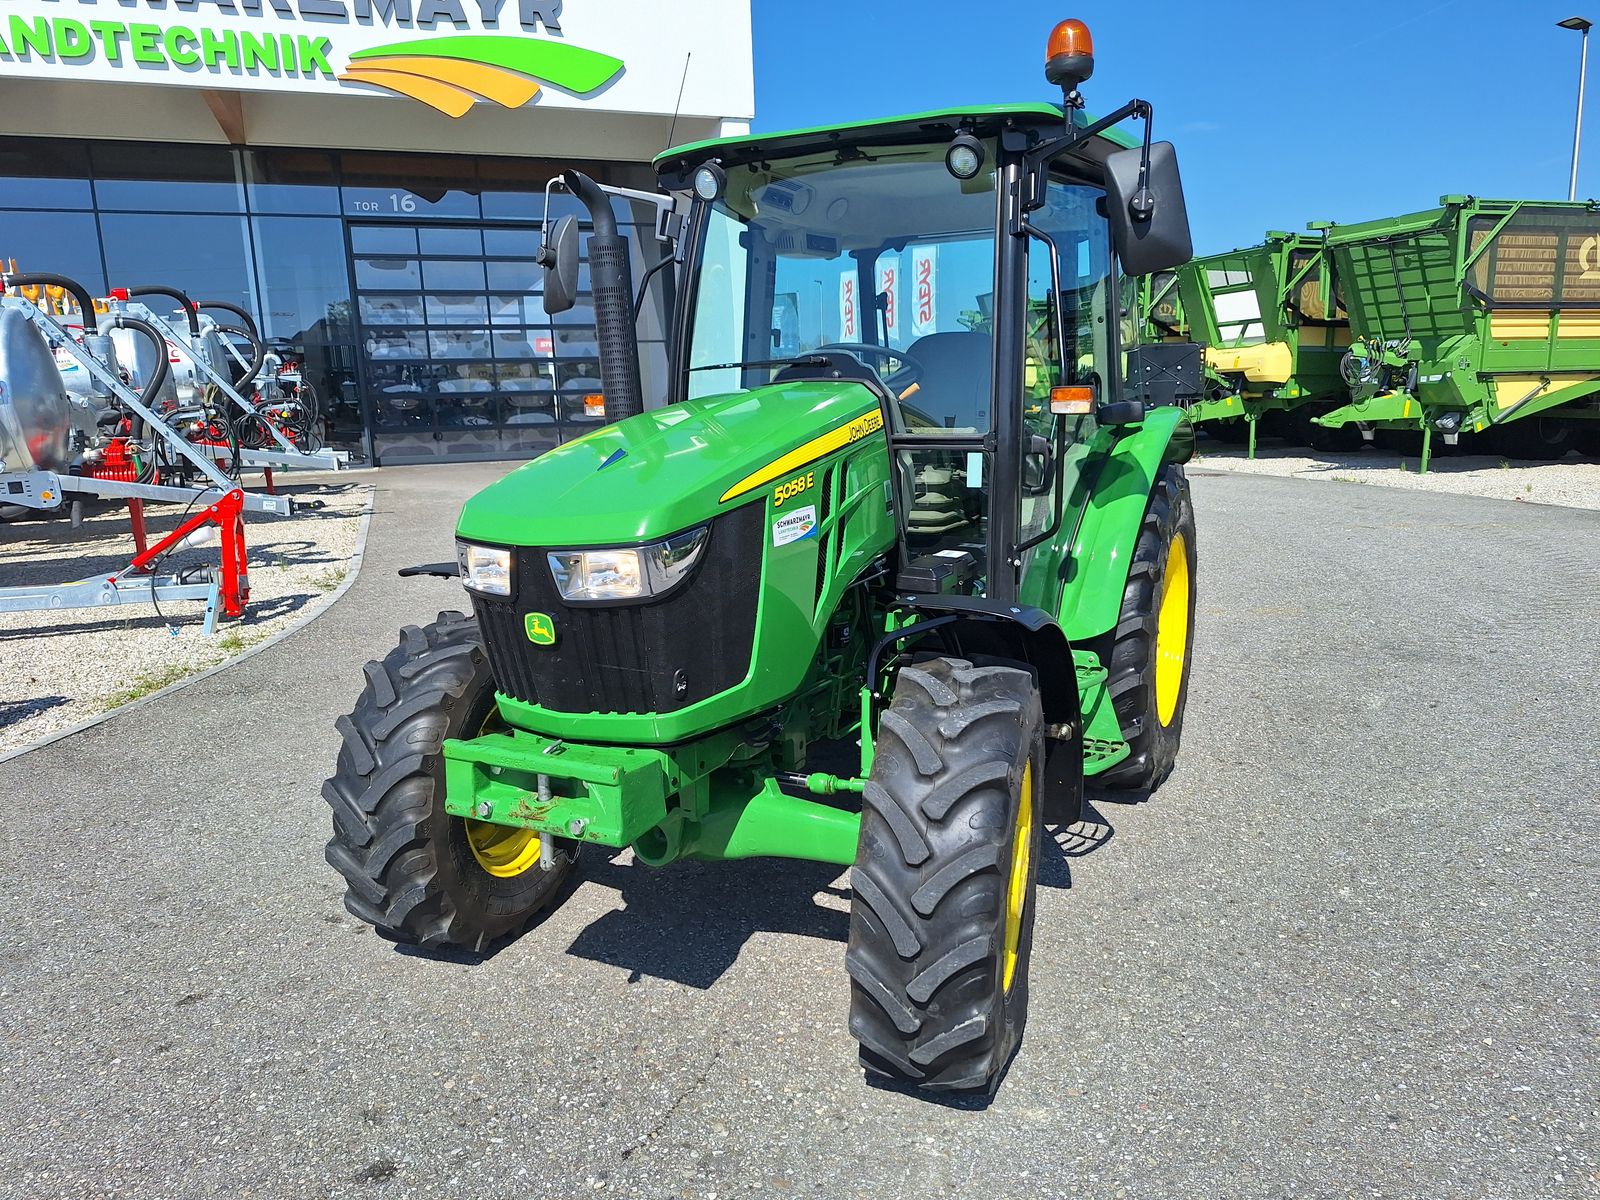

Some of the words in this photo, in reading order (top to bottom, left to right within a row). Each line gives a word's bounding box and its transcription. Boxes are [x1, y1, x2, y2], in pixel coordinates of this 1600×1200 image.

[0, 15, 332, 73] NDTECHNIK
[354, 201, 379, 211] TOR
[389, 193, 416, 213] 16
[848, 422, 865, 442] JOHN
[774, 476, 806, 507] 5058
[806, 471, 815, 489] E
[776, 513, 811, 529] SCHWARZMAYR
